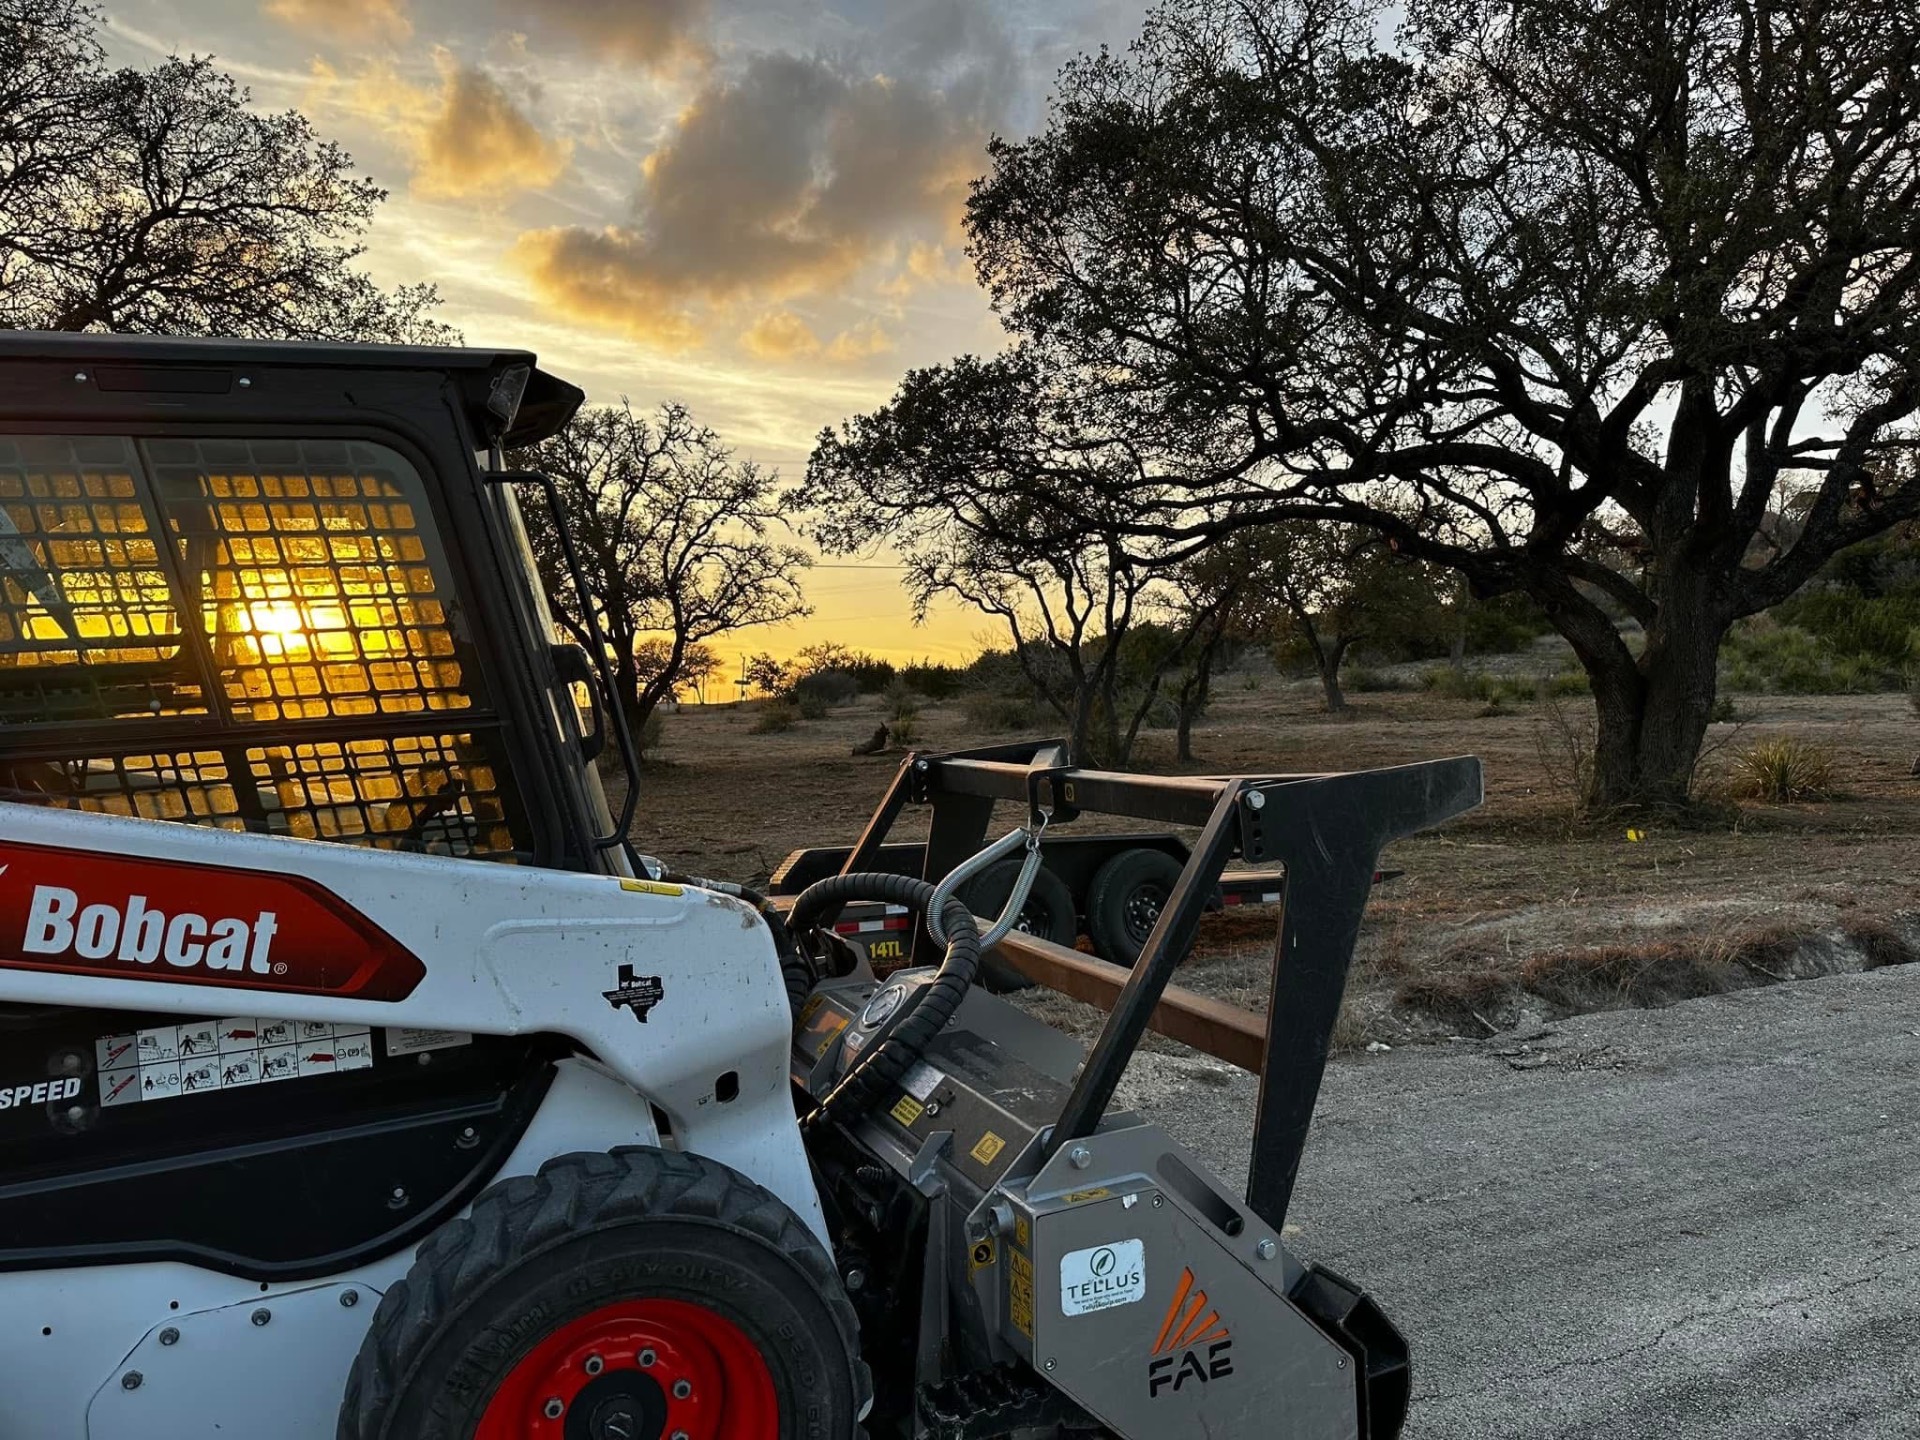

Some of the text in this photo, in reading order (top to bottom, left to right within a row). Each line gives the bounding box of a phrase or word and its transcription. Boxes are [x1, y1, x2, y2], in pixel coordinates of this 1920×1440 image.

[869, 941, 904, 959] 14TL
[0, 1077, 81, 1110] SPEED
[1067, 1272, 1140, 1299] TELLUS
[1149, 1340, 1234, 1398] FAE
